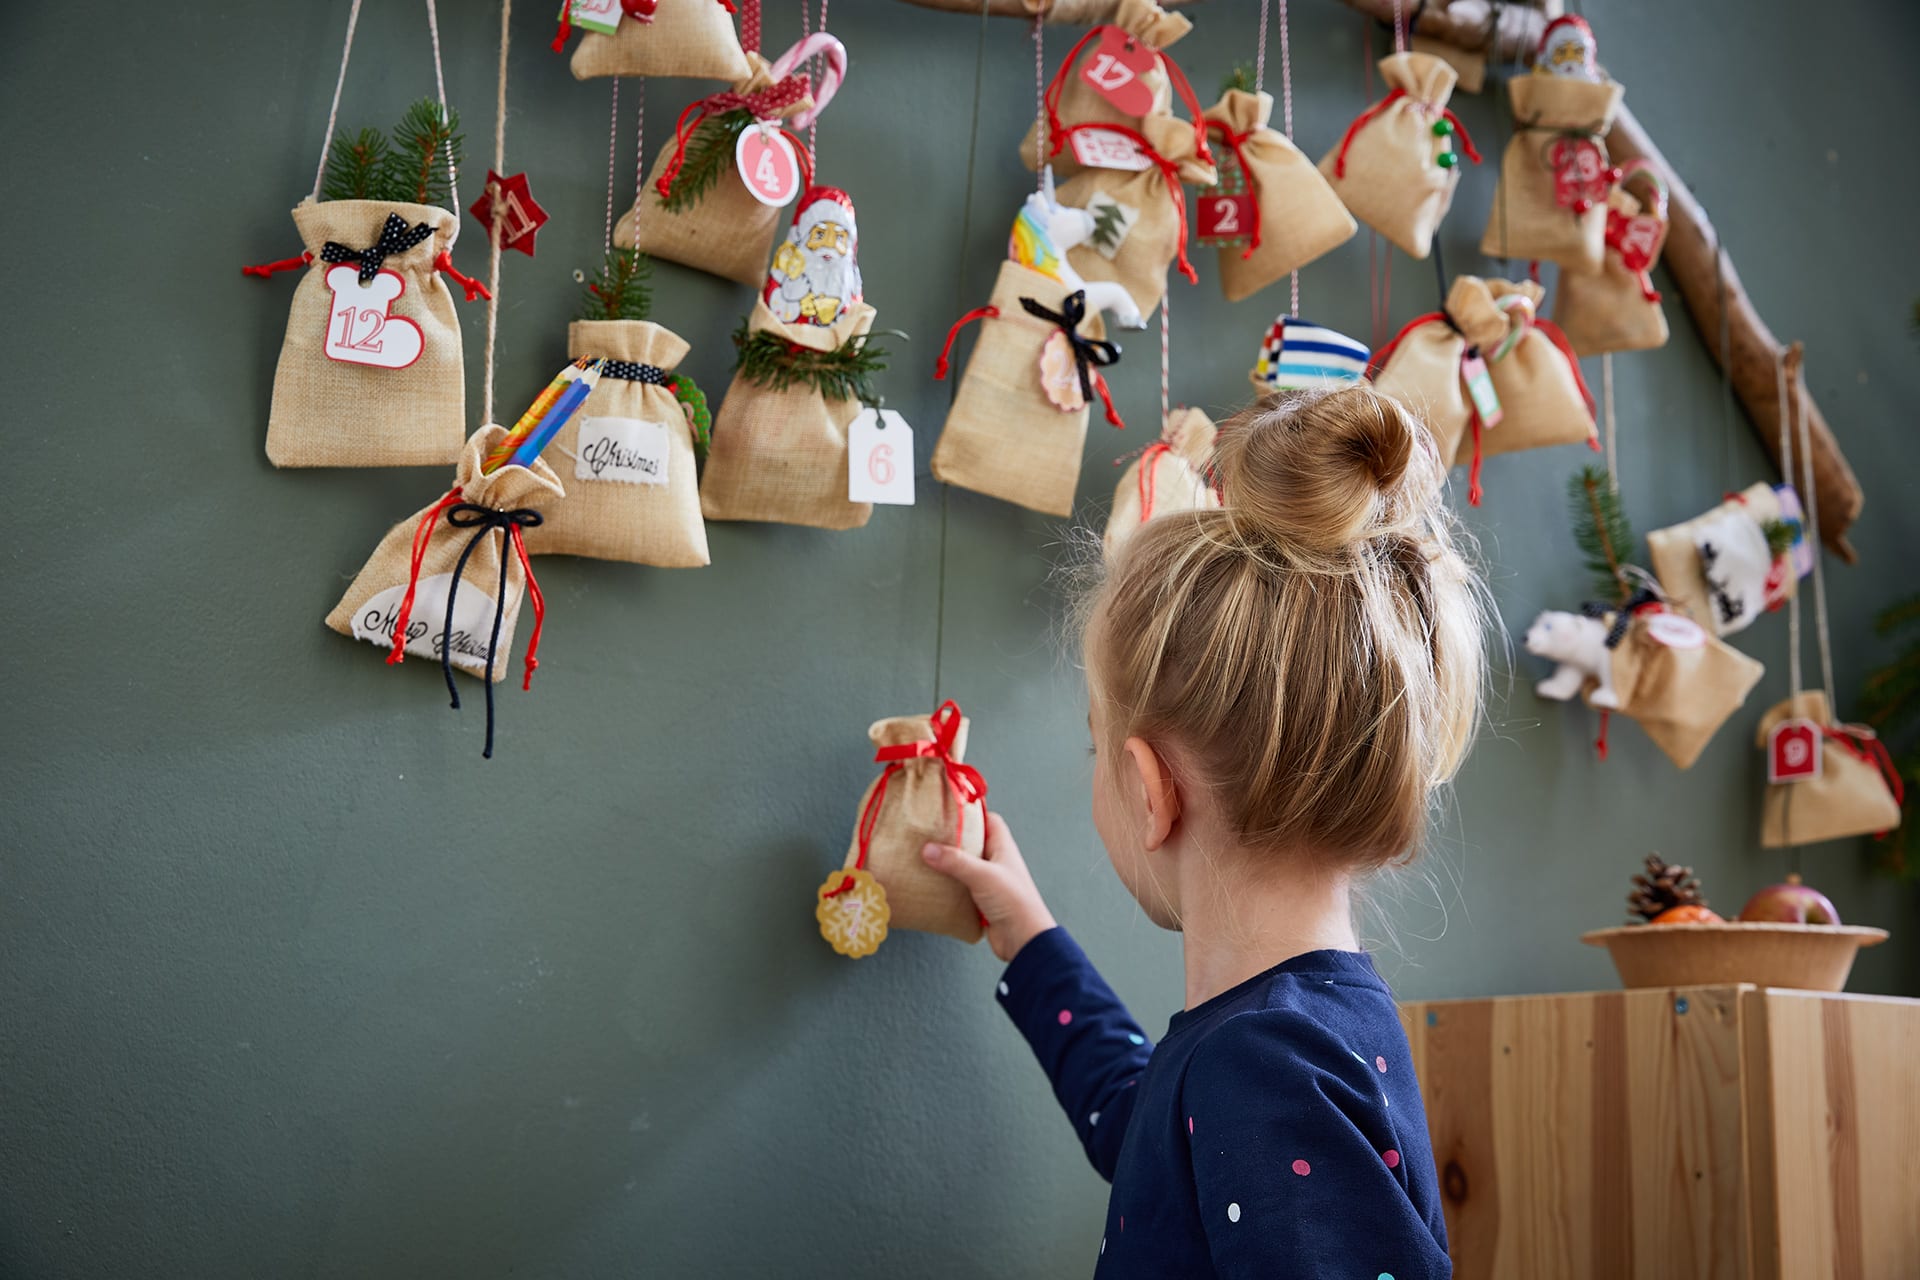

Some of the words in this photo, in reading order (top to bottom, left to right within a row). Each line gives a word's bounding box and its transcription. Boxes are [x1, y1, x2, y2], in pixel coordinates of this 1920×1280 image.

[1086, 53, 1135, 91] 17
[755, 148, 780, 193] 4
[1213, 198, 1239, 233] 2
[335, 305, 386, 354] 12
[868, 443, 895, 486] 6
[843, 899, 862, 938] 7
